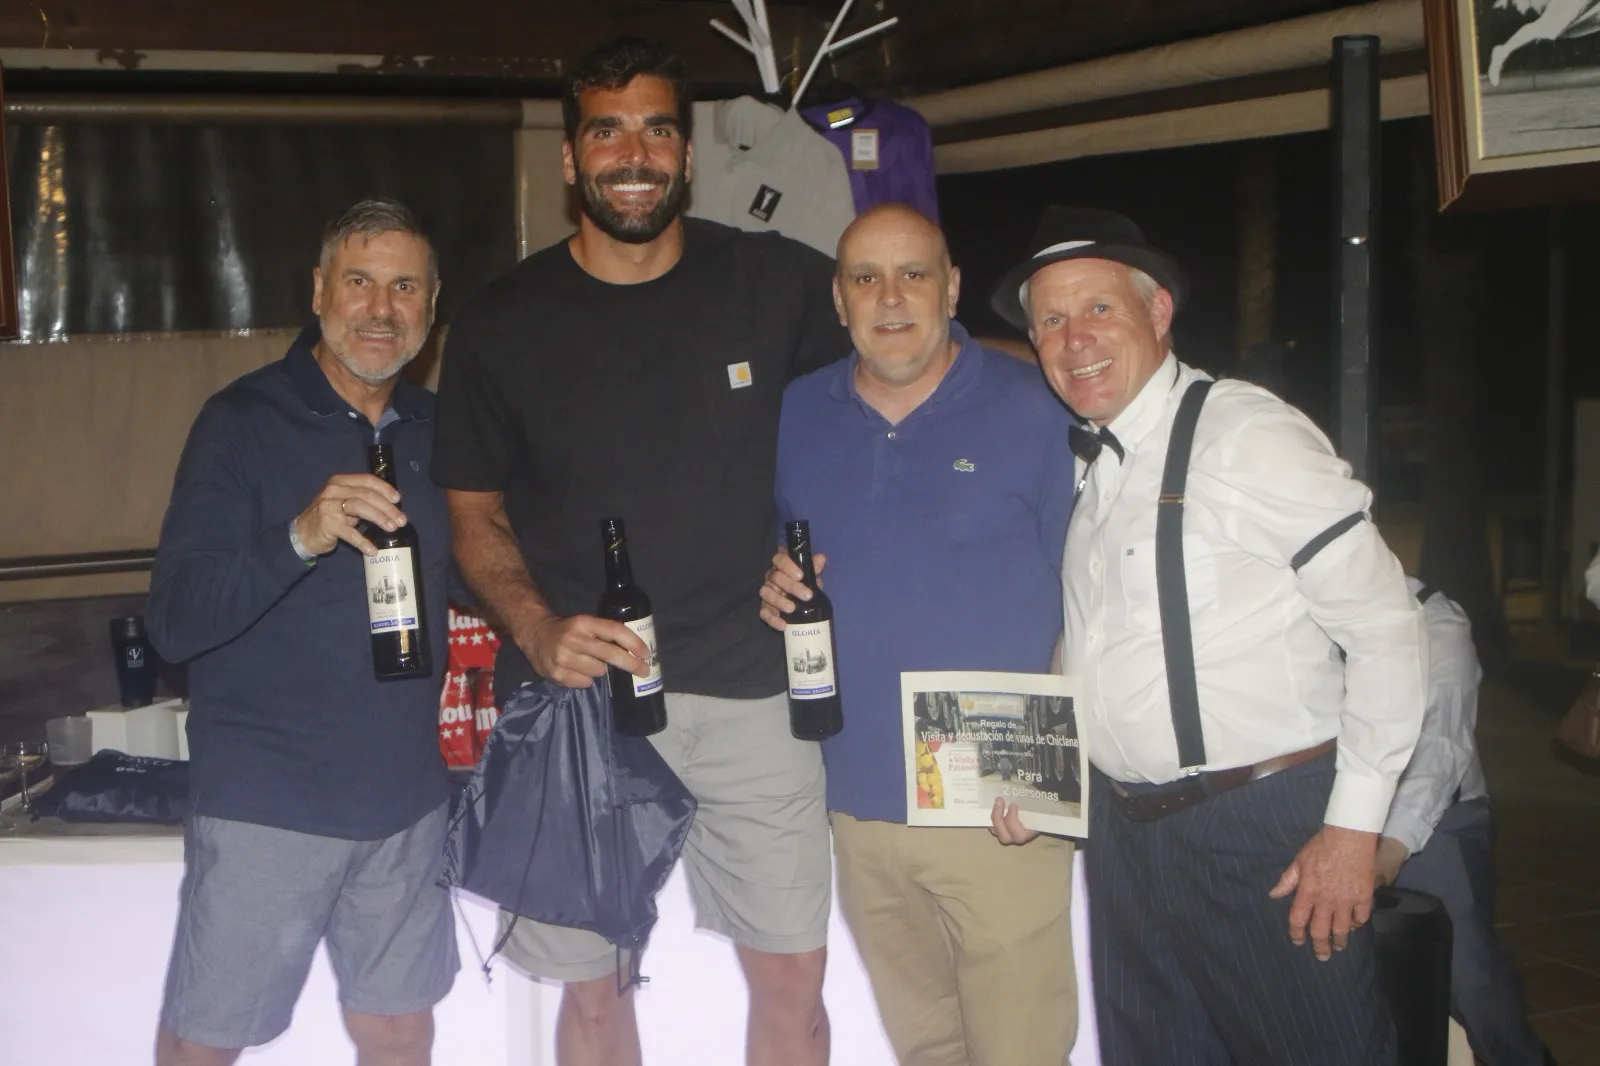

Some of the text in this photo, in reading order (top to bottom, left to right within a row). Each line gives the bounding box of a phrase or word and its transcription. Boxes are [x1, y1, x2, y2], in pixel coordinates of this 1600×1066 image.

[369, 554, 400, 565] GLORIA
[791, 628, 821, 637] GLORIA
[980, 719, 1017, 729] Regalo de
[921, 729, 1079, 748] Visita y degustación de vinos de Chiclana
[1017, 769, 1043, 783] Para
[1002, 784, 1059, 801] 2 personas
